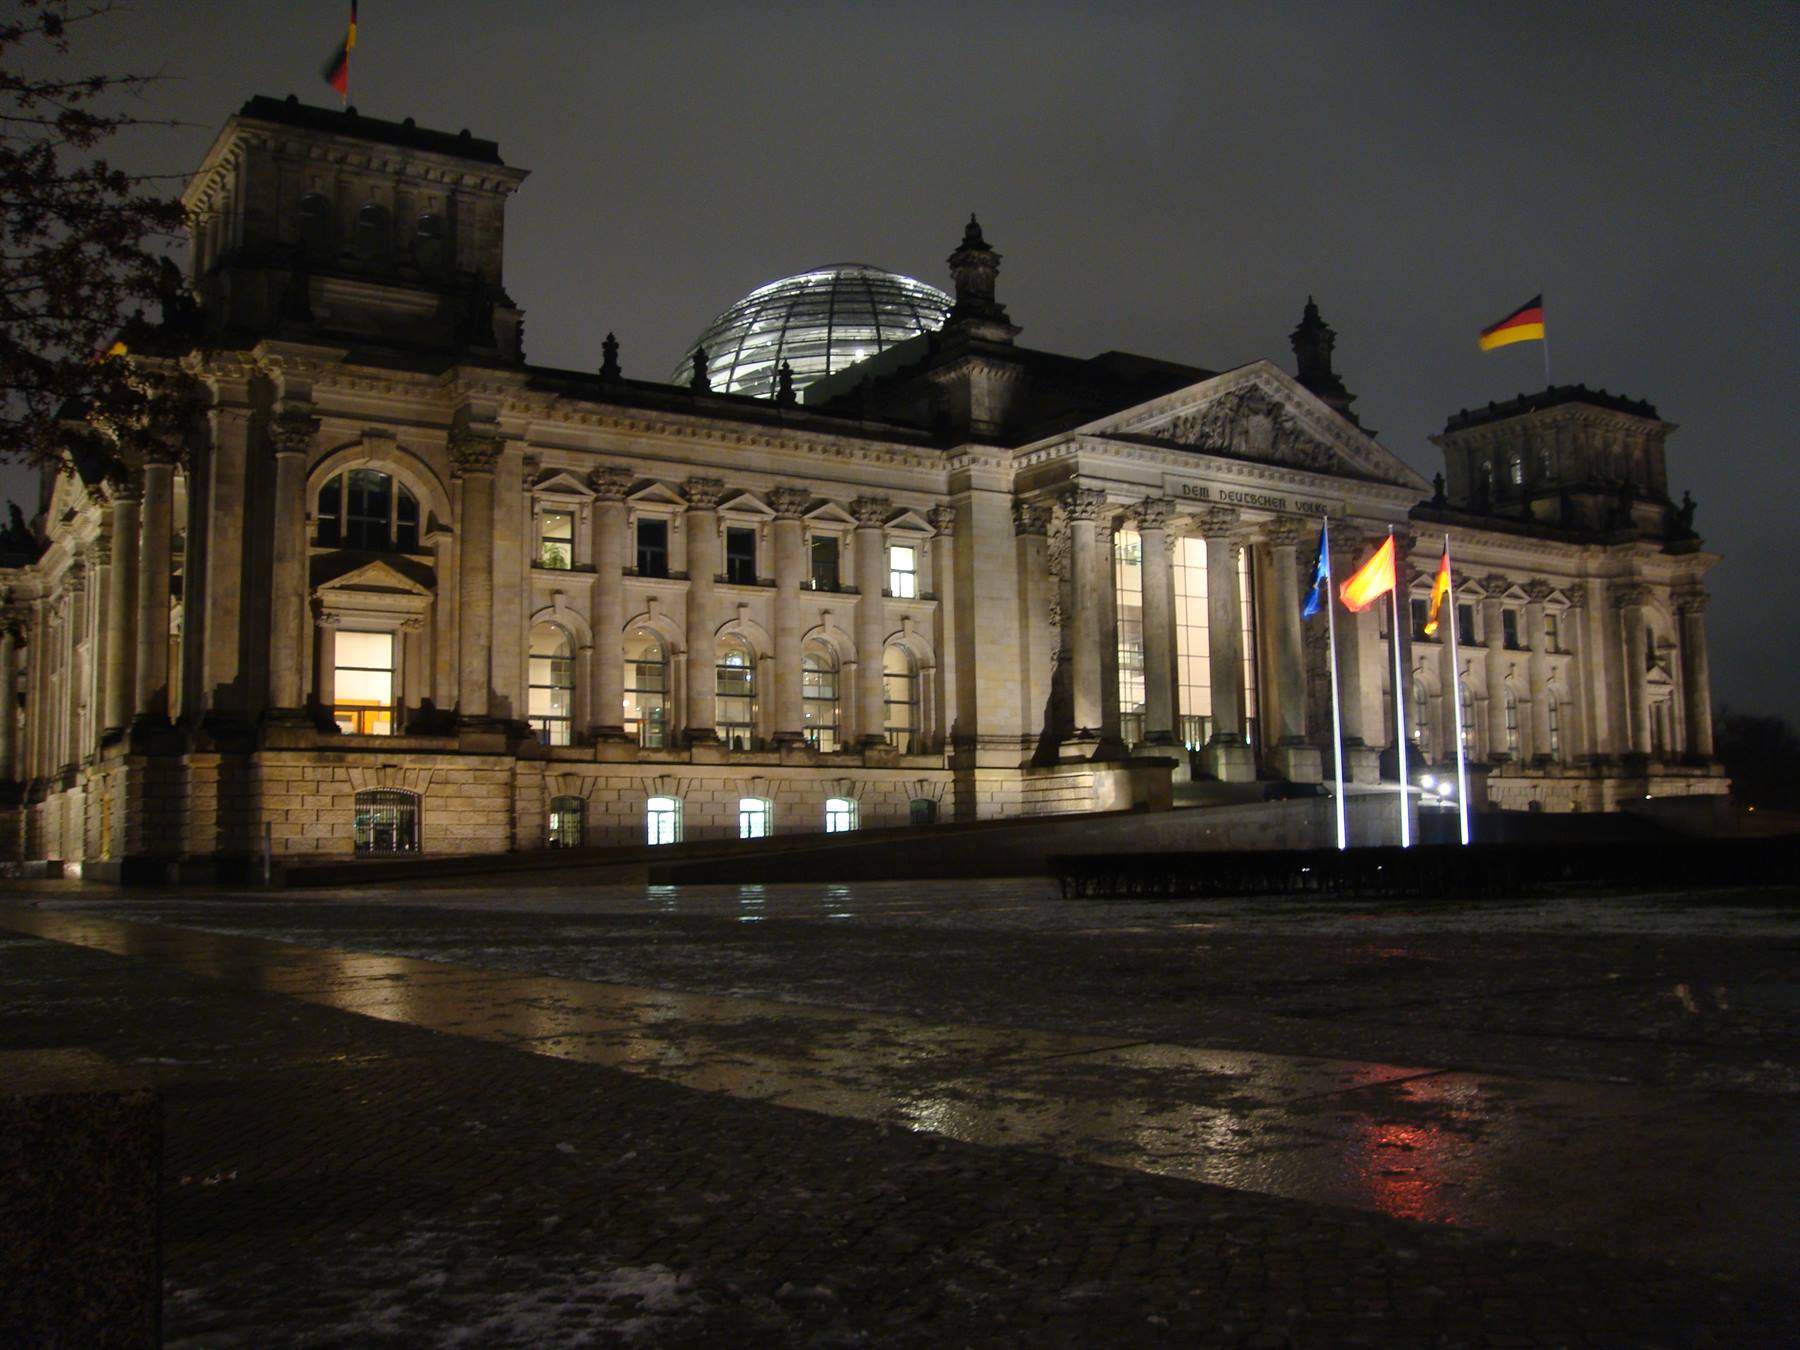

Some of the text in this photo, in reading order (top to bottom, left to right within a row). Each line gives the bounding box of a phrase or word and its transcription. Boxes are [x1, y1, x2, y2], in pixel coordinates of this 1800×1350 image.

[1182, 484, 1328, 514] DEM DEUTSCHEN VOLKE
